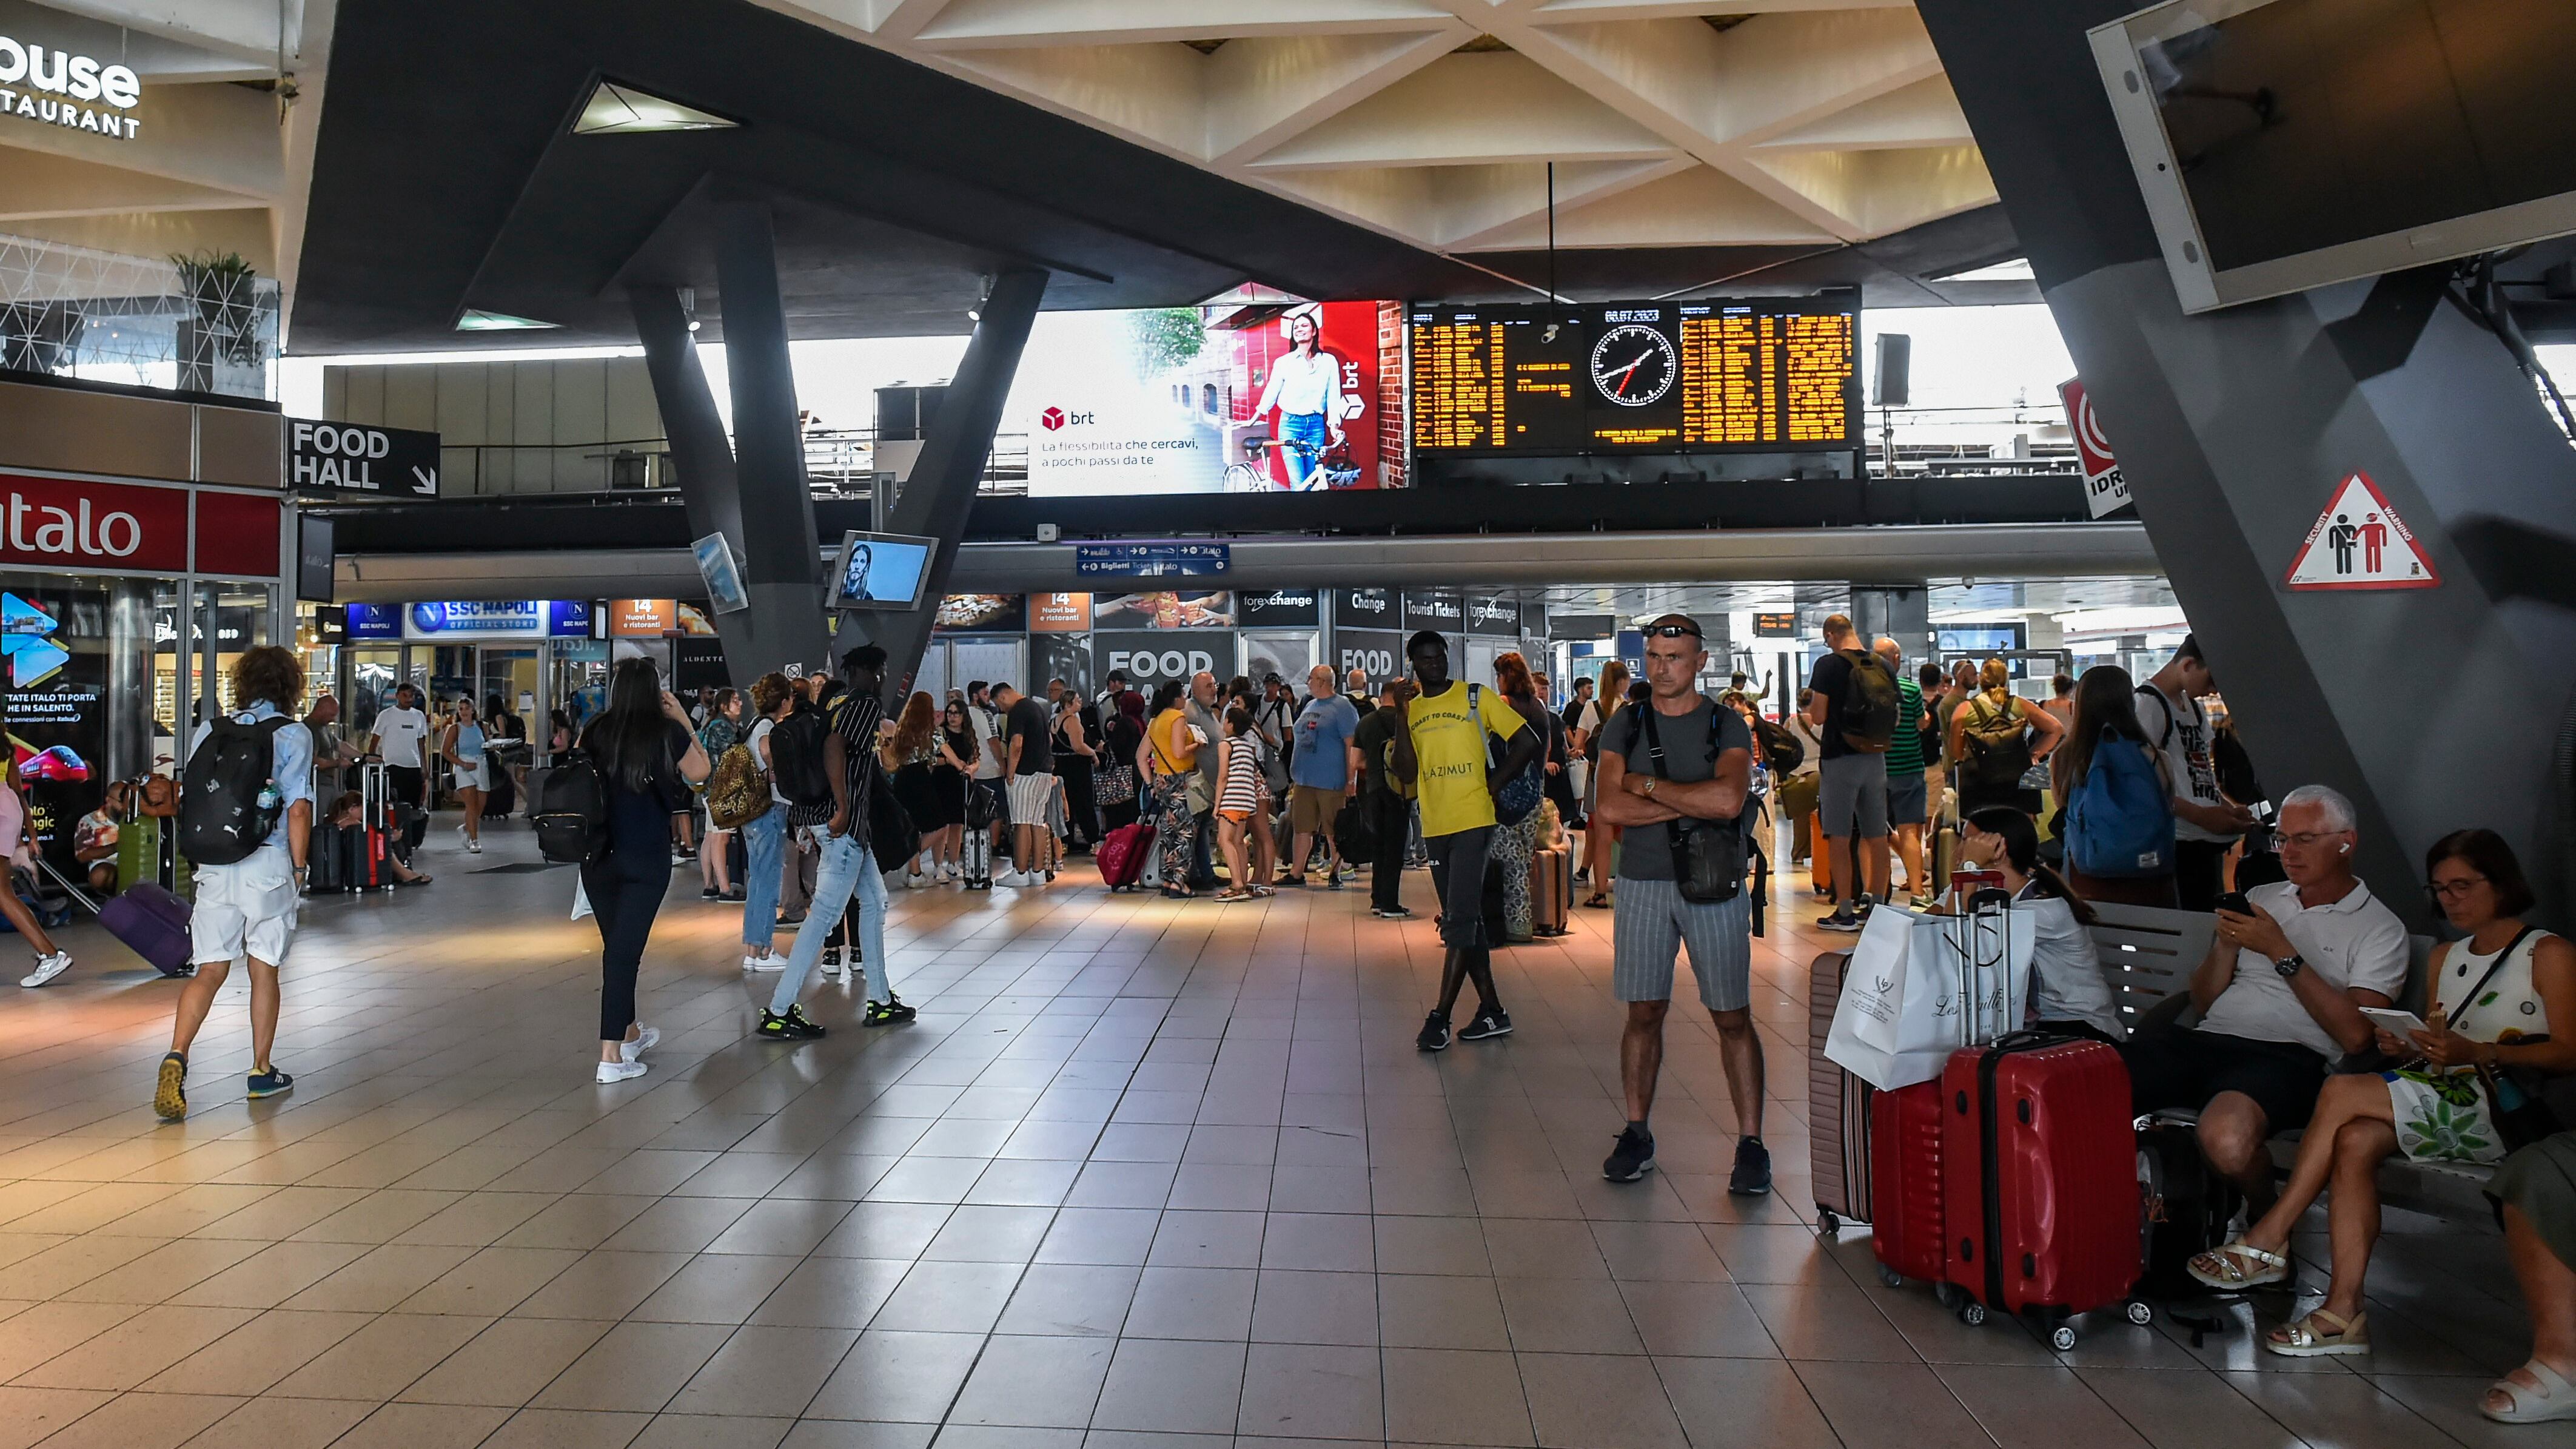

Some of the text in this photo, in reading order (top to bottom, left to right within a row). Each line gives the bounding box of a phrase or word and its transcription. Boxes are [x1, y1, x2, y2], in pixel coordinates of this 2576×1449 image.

[1342, 361, 1358, 389] brt
[1071, 411, 1094, 425] brt
[294, 423, 389, 459] FOOD
[1042, 443, 1055, 451] La
[1125, 440, 1147, 449] che
[1152, 438, 1198, 449] cercavi,
[1052, 457, 1085, 468] pochi
[1090, 457, 1119, 468] passi
[1123, 456, 1137, 465] da
[1141, 456, 1153, 465] te
[294, 455, 379, 489] HALL
[2304, 511, 2329, 545] SECURITY
[2384, 506, 2413, 542] WARNING
[632, 599, 652, 613] 14
[1052, 593, 1069, 605] 14
[1244, 594, 1312, 608] forexchange
[1352, 593, 1385, 613] Change
[449, 602, 537, 616] SSC NAPOLI
[1407, 600, 1460, 617] Tourist Tickets
[1469, 602, 1516, 624] forexchange
[450, 619, 535, 628] OFFICIAL STORE
[1109, 650, 1213, 677] FOOD
[1342, 649, 1392, 676] FOOD
[5, 693, 29, 702] TATE
[30, 693, 56, 702] ITALO
[68, 693, 96, 702] PORTA
[33, 704, 74, 712] SALENTO.
[1410, 715, 1430, 731] COAST
[1442, 712, 1466, 722] COAST
